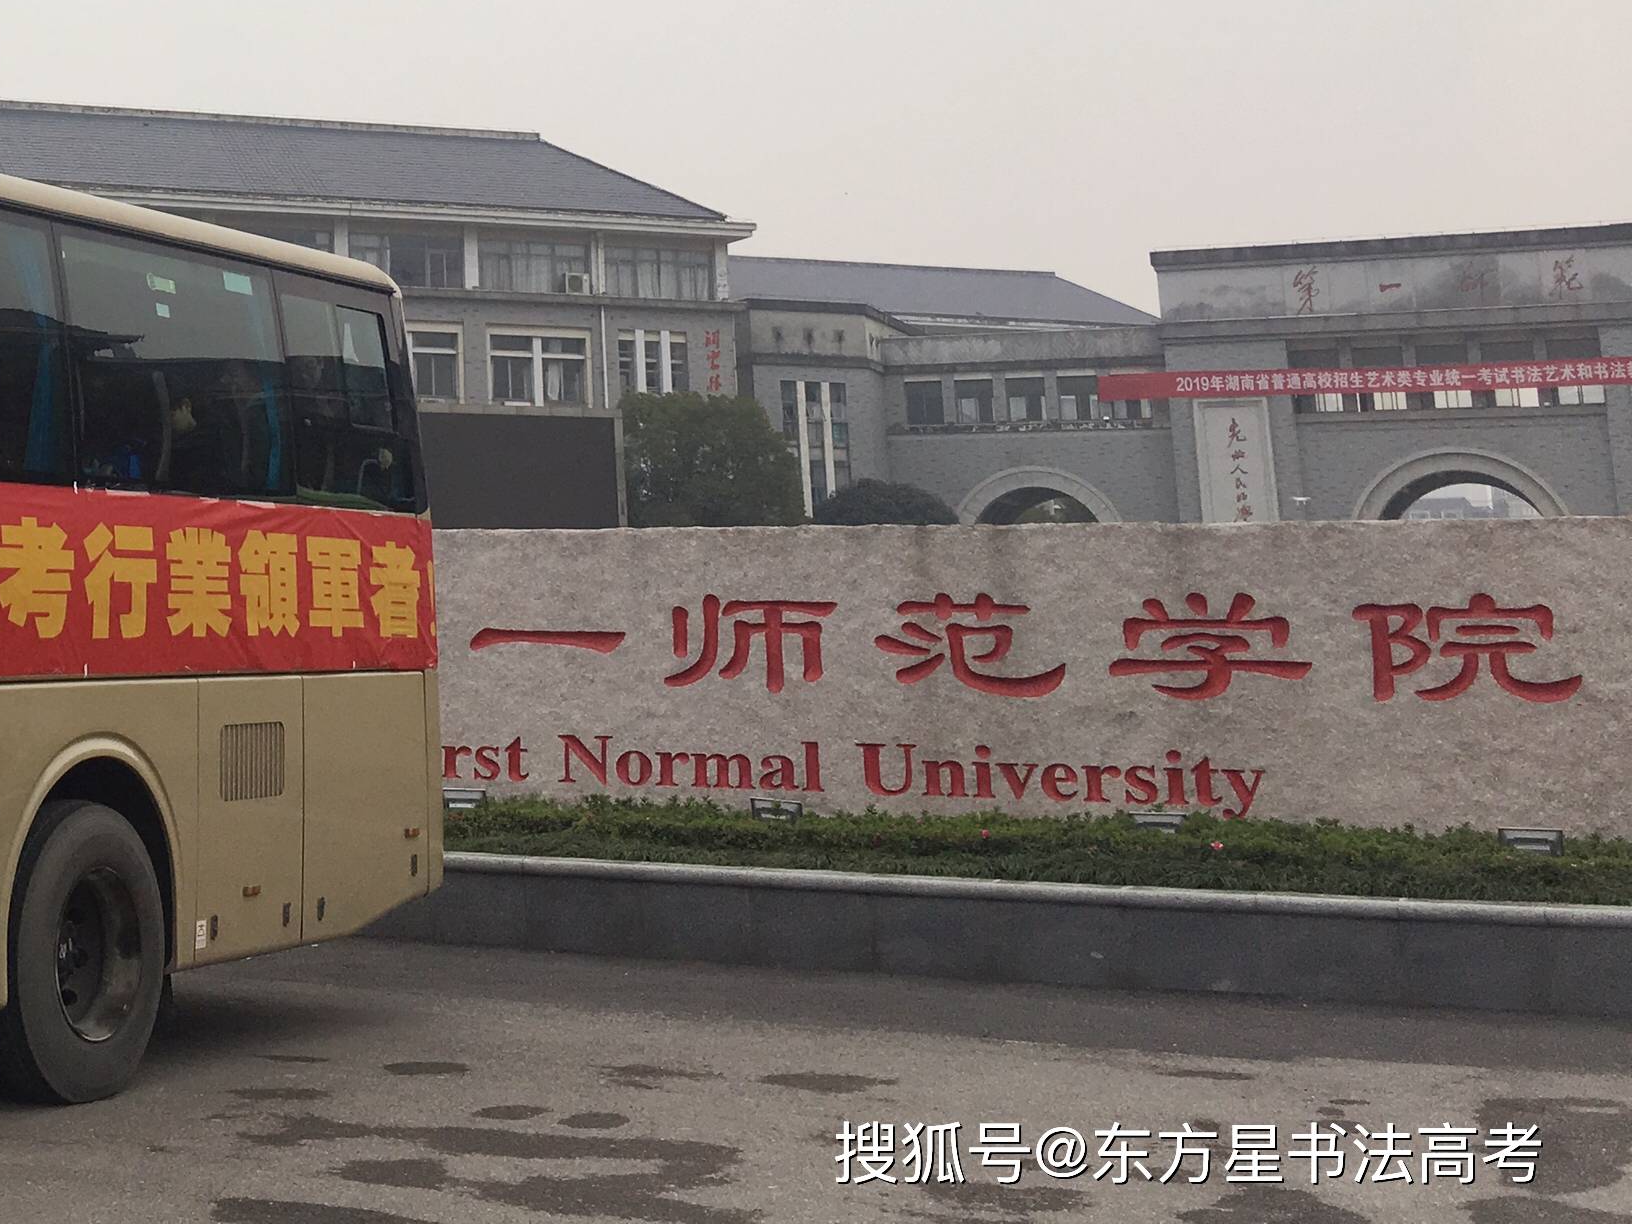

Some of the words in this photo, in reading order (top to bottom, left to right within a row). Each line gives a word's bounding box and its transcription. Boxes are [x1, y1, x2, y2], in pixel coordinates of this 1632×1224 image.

[469, 593, 1584, 704] 一师范学院
[557, 733, 825, 793] Normal
[855, 741, 1266, 820] University
